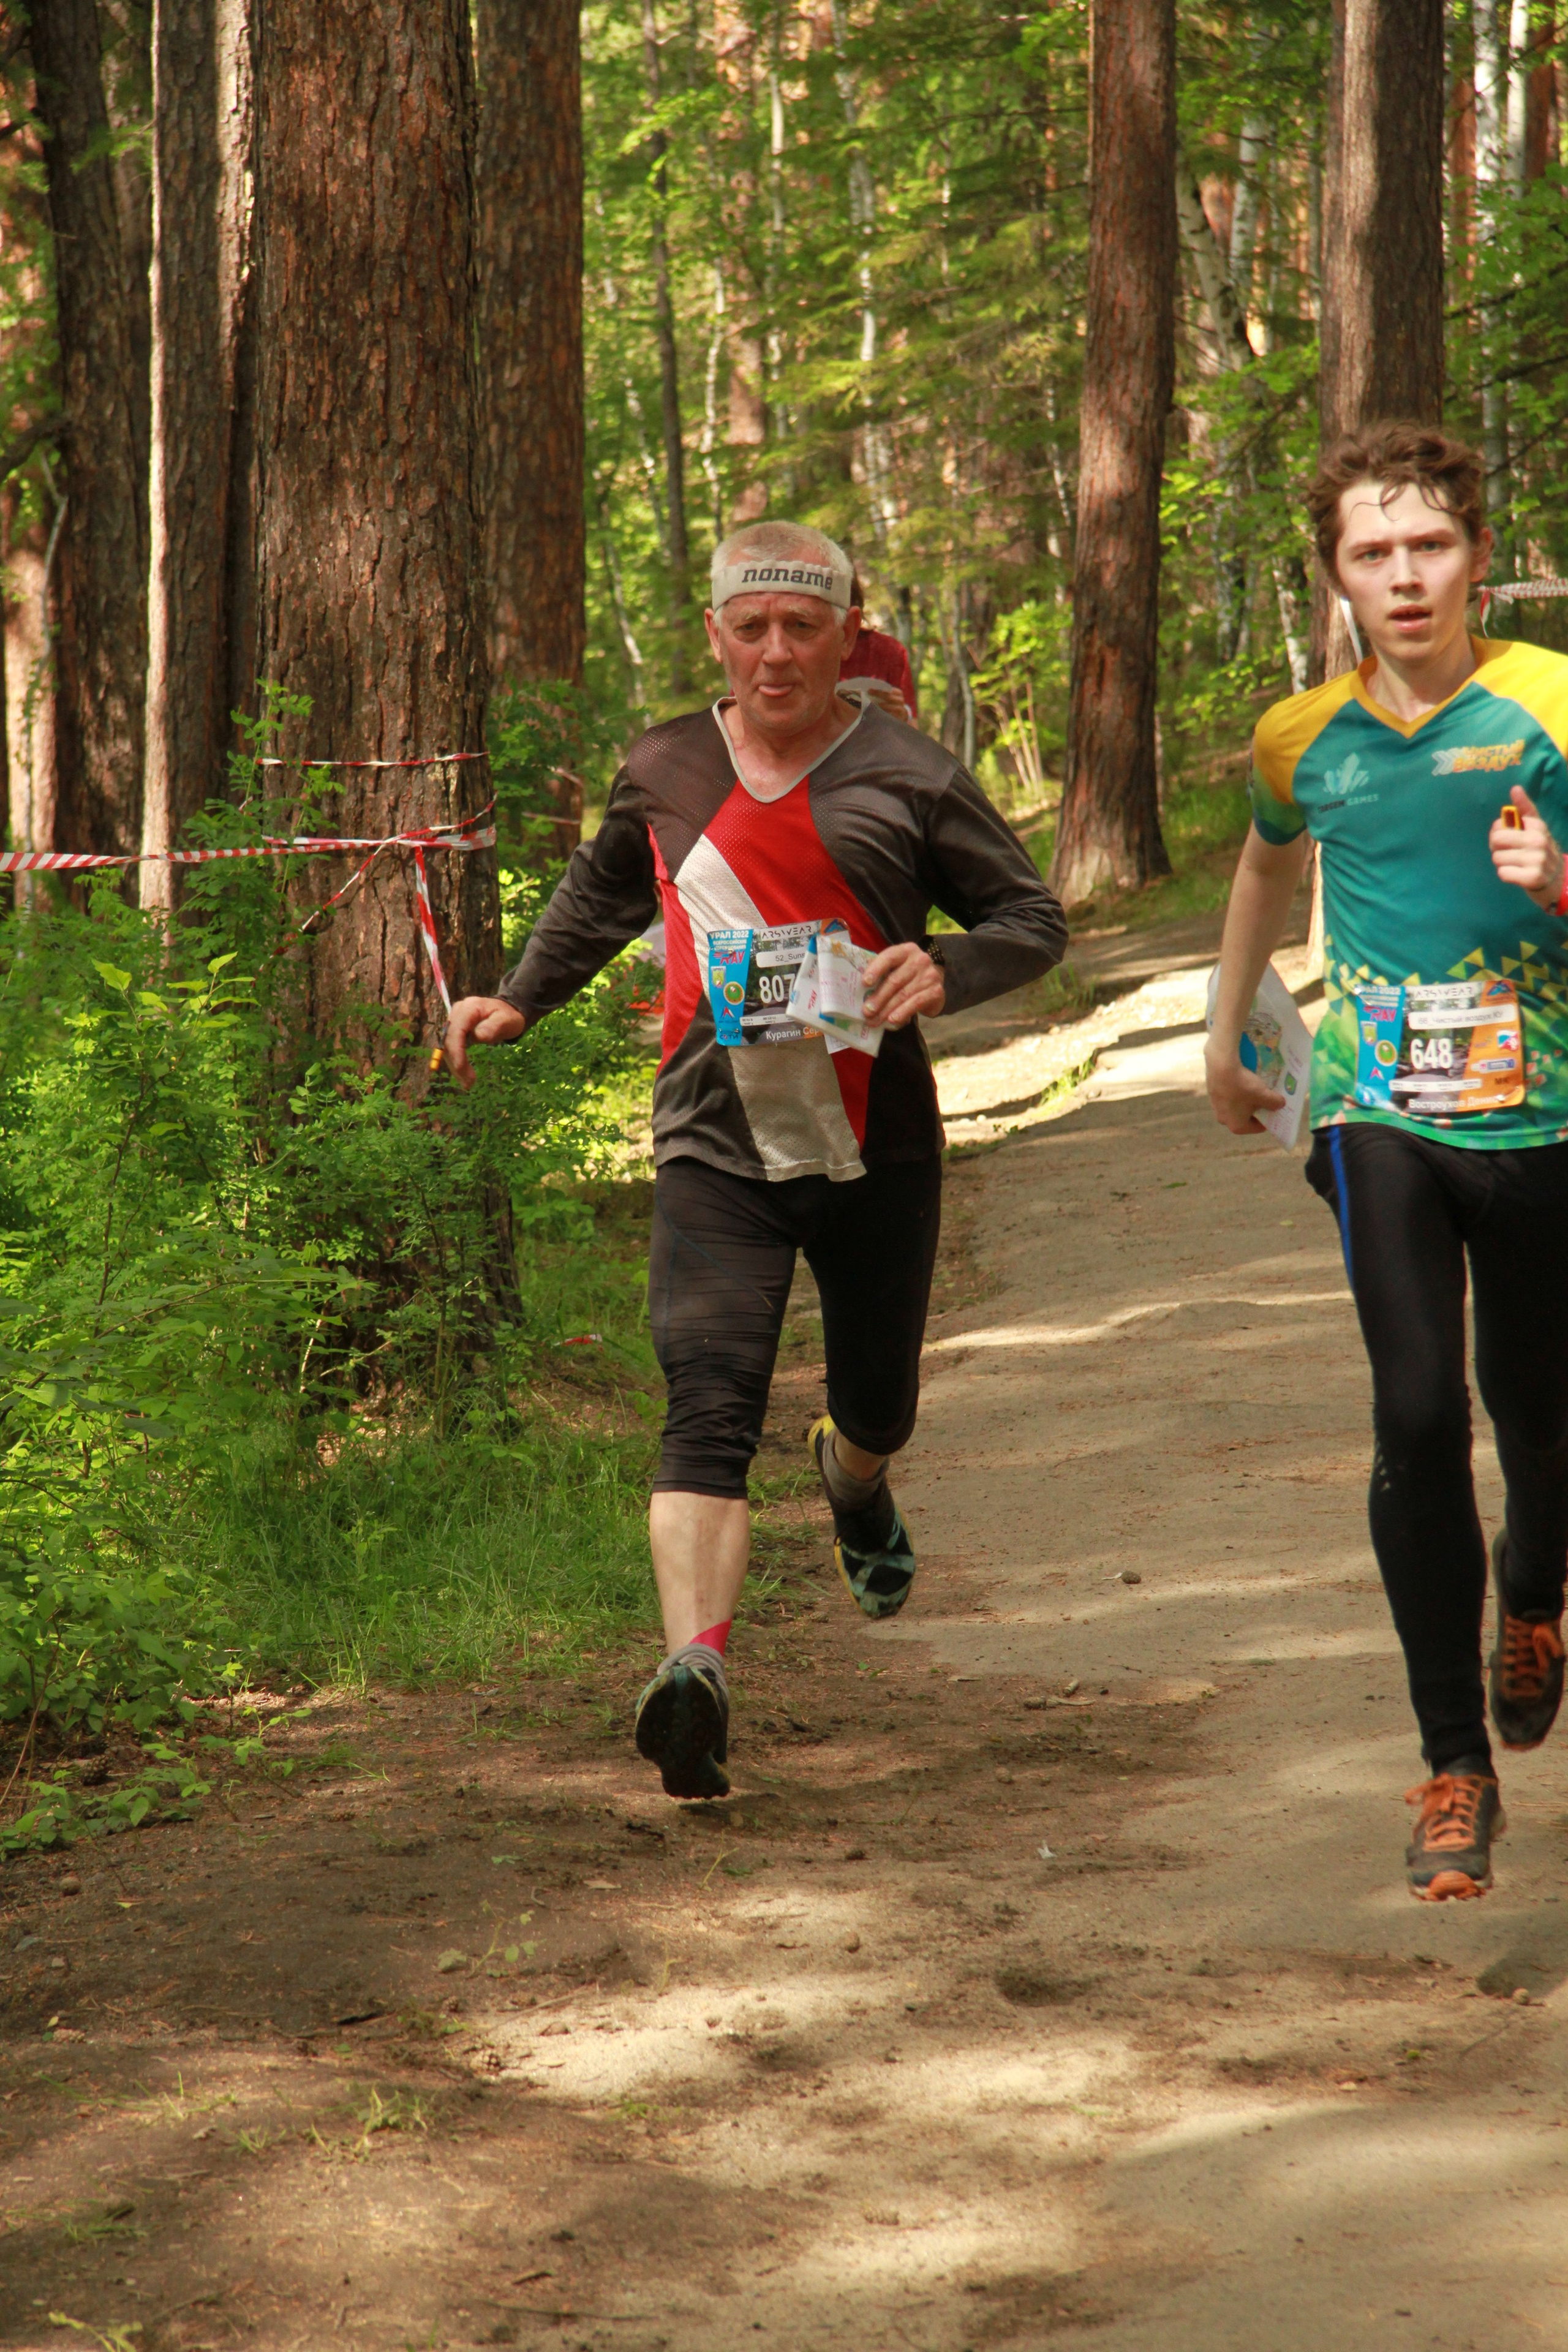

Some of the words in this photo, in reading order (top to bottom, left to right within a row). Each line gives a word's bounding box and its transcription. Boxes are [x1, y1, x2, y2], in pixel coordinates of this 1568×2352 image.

[742, 568, 832, 590] noname
[1452, 751, 1521, 773] ВОЗДУХ
[759, 973, 797, 1003] 807
[766, 1030, 801, 1041] Курагин
[1411, 1038, 1453, 1069] 648
